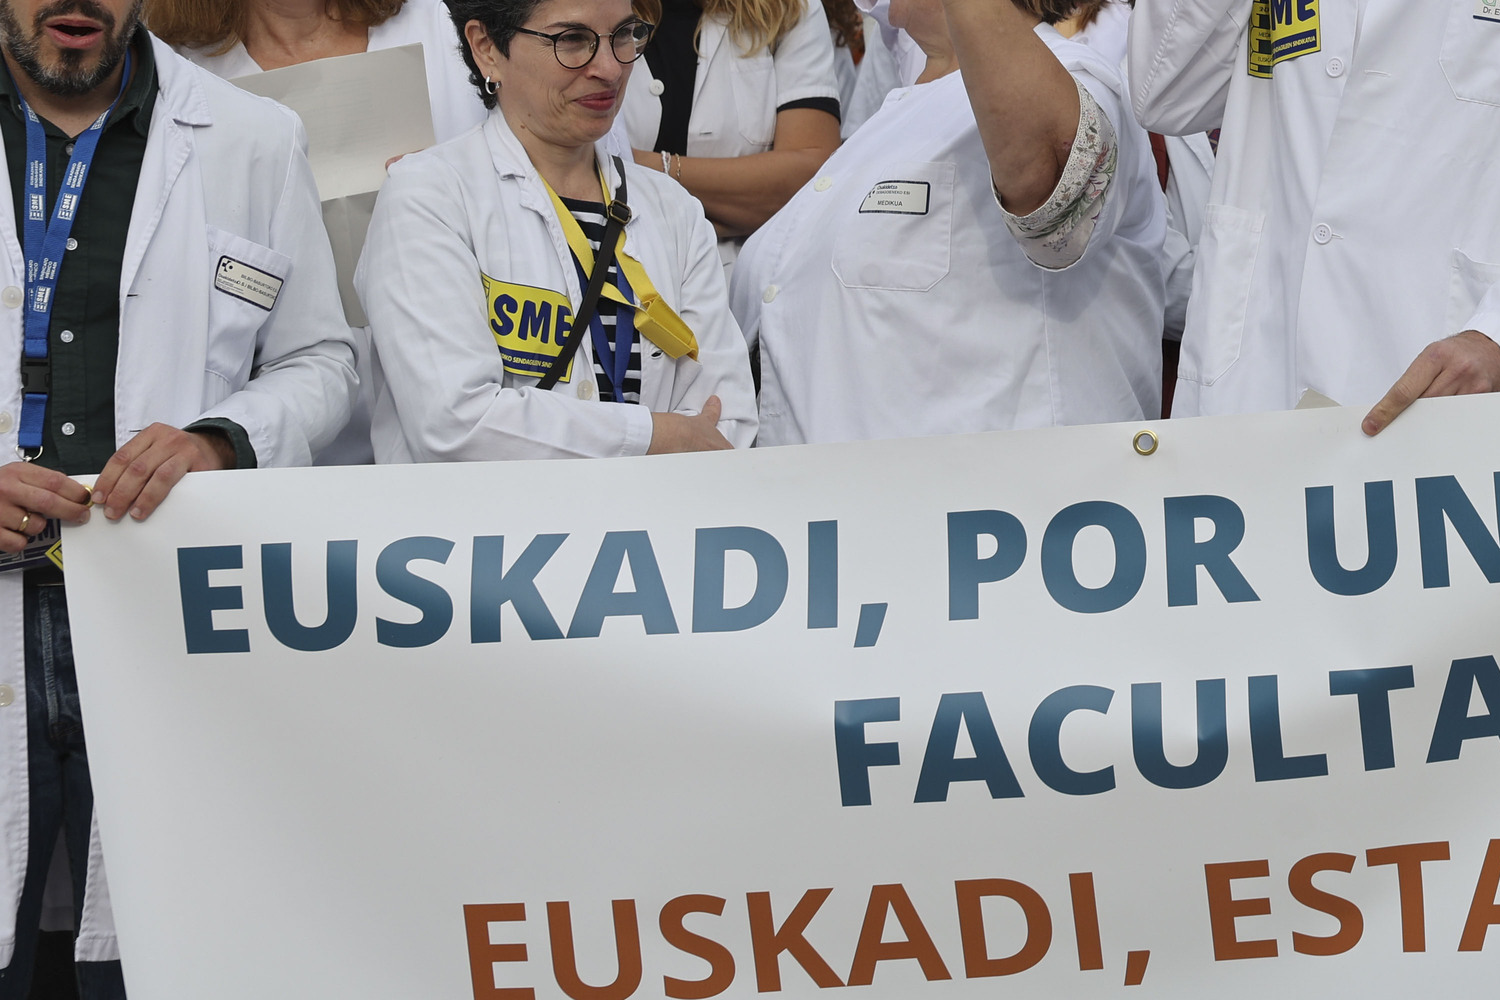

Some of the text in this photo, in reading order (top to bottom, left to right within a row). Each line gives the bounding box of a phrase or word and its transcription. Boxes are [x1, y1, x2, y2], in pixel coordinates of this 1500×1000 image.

[1482, 6, 1493, 14] Dr.
[491, 294, 573, 347] SME
[178, 521, 888, 649] EUSKADI,
[948, 496, 1260, 620] POR
[463, 872, 1150, 1000] EUSKADI,
